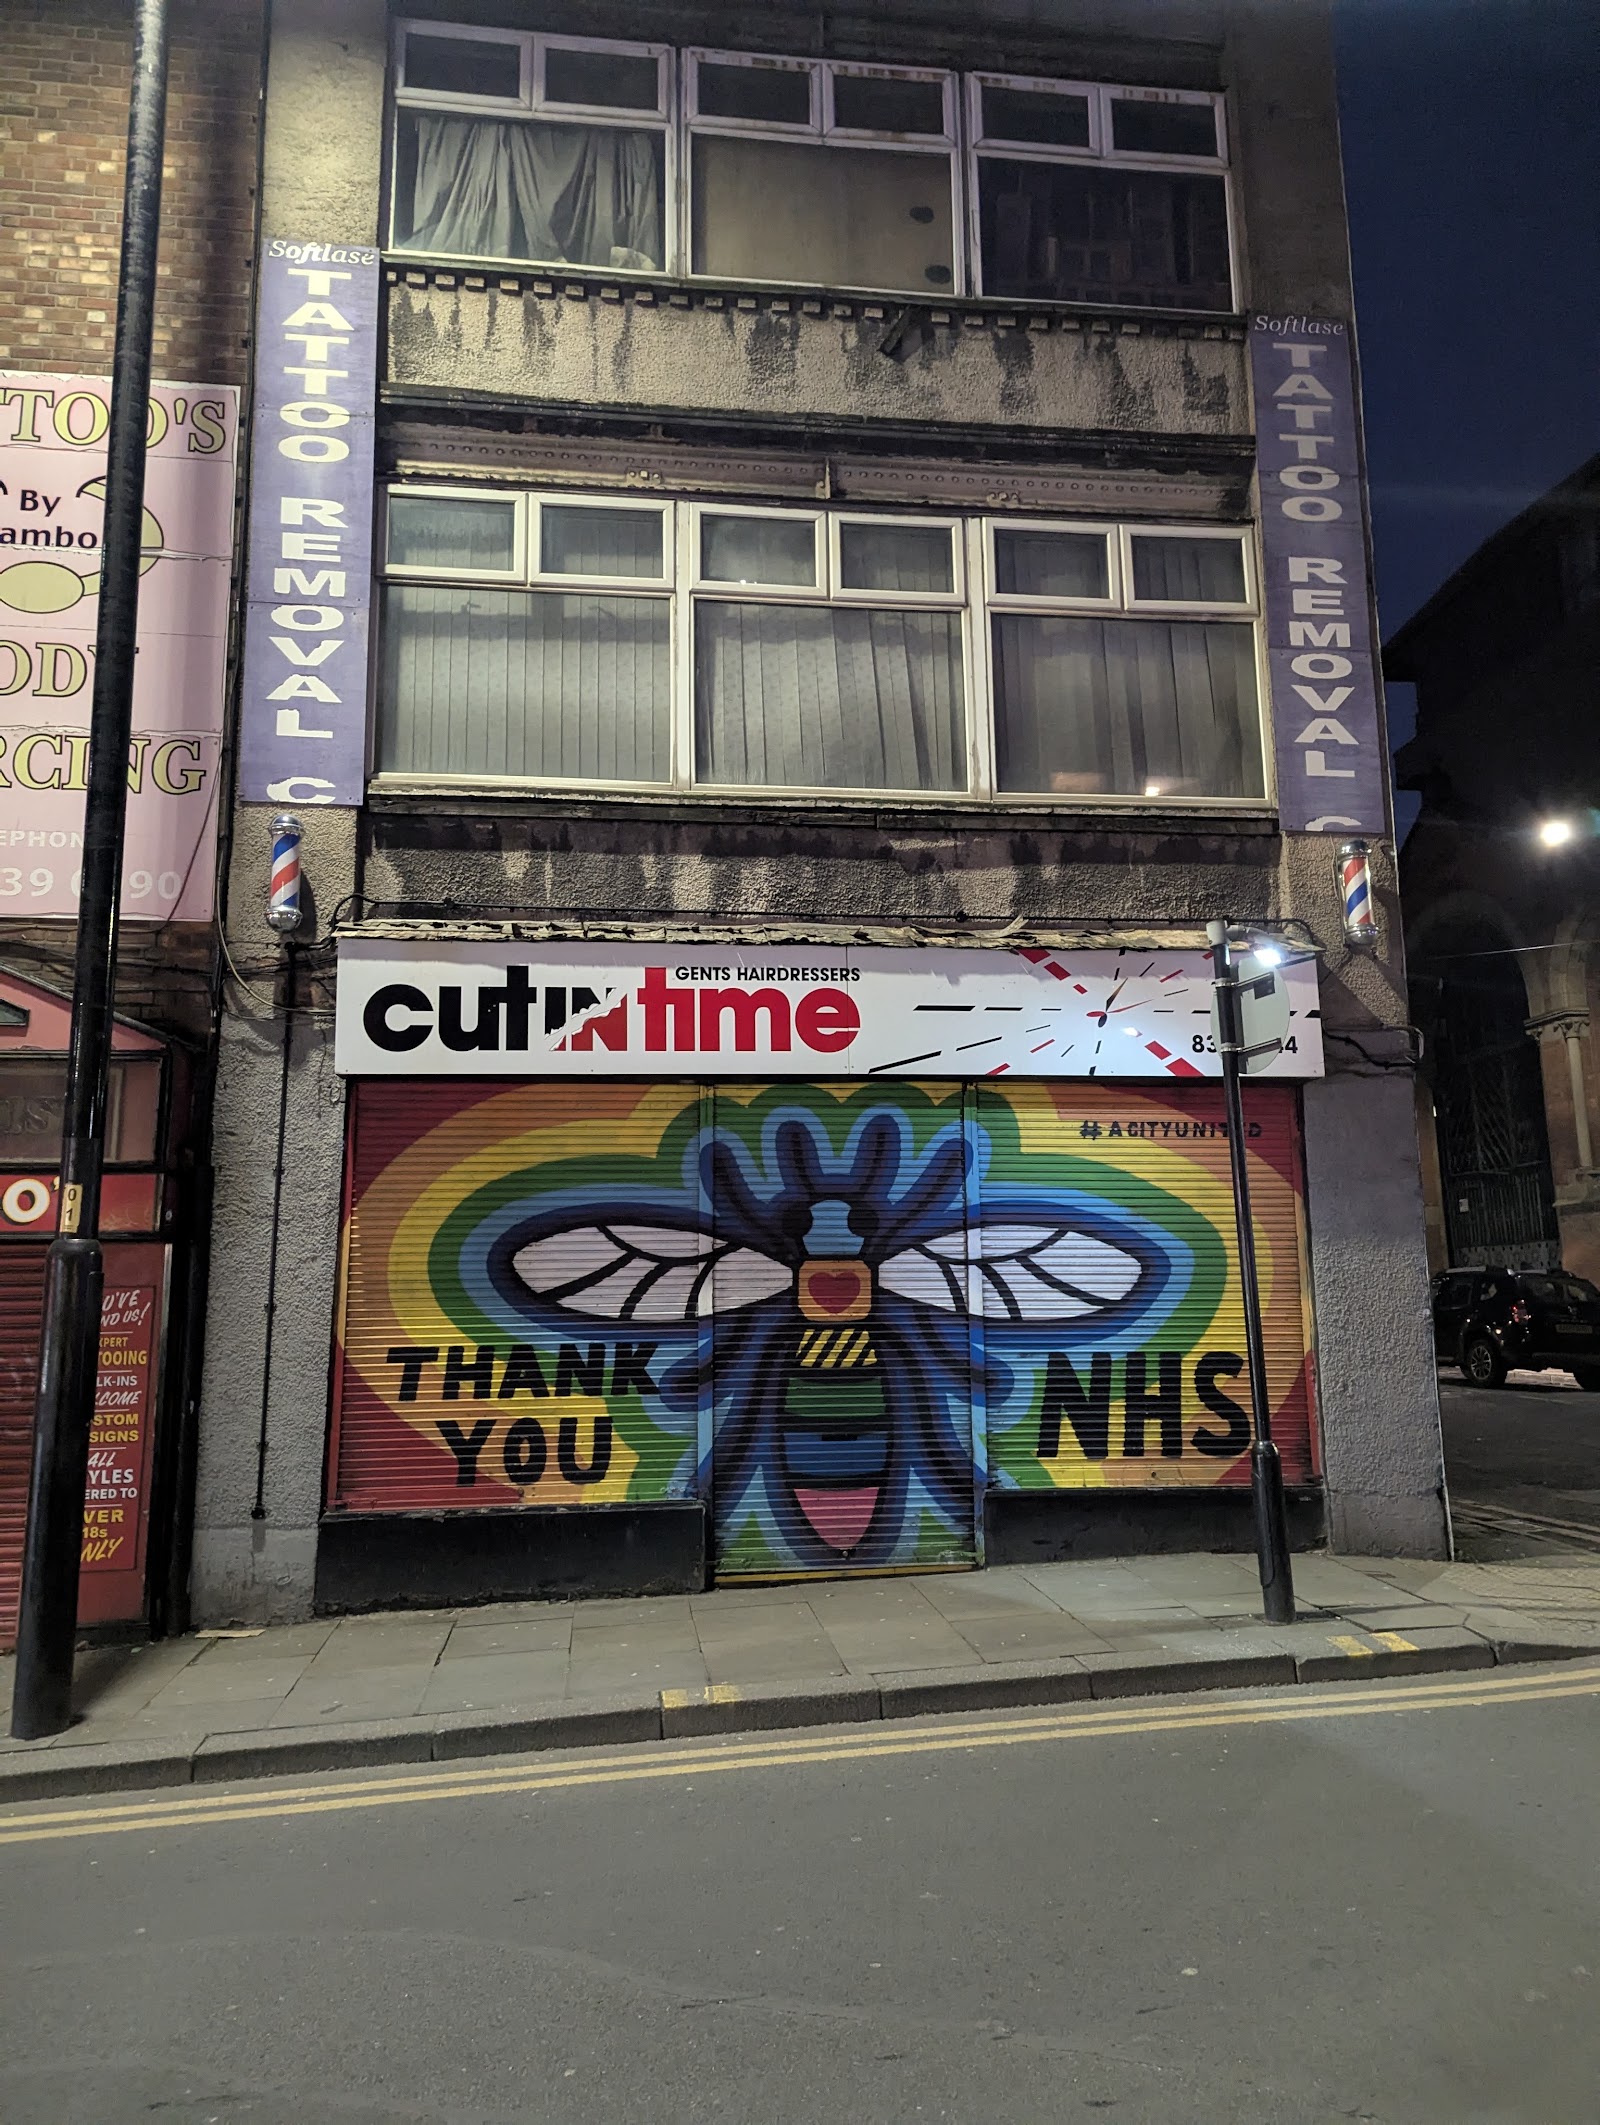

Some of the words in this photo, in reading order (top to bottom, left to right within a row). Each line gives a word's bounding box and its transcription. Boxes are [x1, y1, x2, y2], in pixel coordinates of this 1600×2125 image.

[269, 240, 375, 265] Softlase
[1255, 315, 1346, 336] Softlase
[278, 268, 355, 463] TATTOO
[0, 388, 226, 453] TO'S
[1273, 342, 1342, 522] TATTOO
[20, 489, 61, 517] By
[266, 496, 348, 738] REMOVAL
[1288, 557, 1359, 778] REMOVAL
[675, 966, 731, 981] GENTS
[737, 966, 861, 982] HAIRDRESSERS
[363, 965, 537, 1052] cut
[637, 966, 861, 1052] time
[102, 1290, 140, 1311] U'VE
[96, 1375, 138, 1387] LK-INS
[386, 1342, 661, 1401] THANK
[1037, 1351, 1251, 1458] NHS
[92, 1413, 139, 1426] STOM
[89, 1430, 139, 1443] SIGNS
[87, 1452, 116, 1467] ALL
[435, 1416, 613, 1487] YOU
[88, 1469, 134, 1484] YLES
[120, 1488, 138, 1499] TO
[83, 1509, 124, 1523] VER
[81, 1537, 124, 1562] NLY
